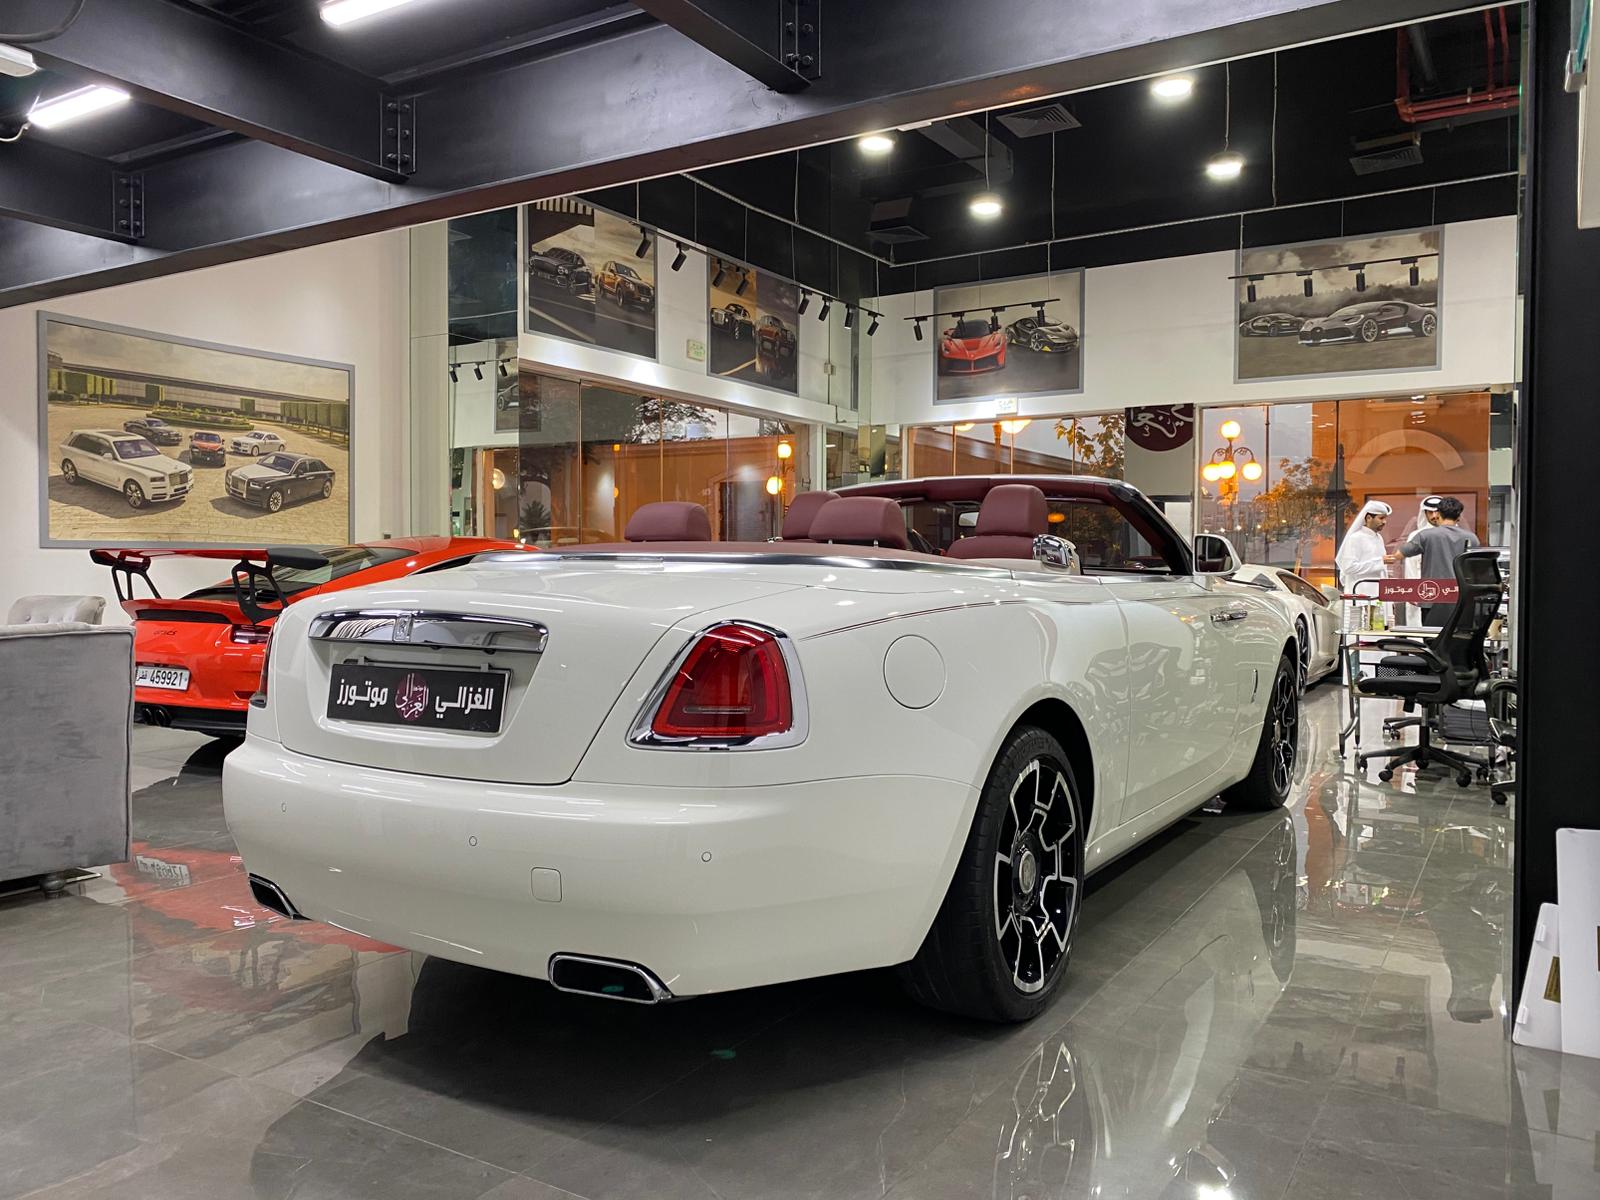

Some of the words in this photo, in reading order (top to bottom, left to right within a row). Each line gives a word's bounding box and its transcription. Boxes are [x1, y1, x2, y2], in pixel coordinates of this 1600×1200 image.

[149, 669, 183, 687] 459921
[336, 678, 388, 708] موتورز
[435, 686, 494, 719] الغزالي
